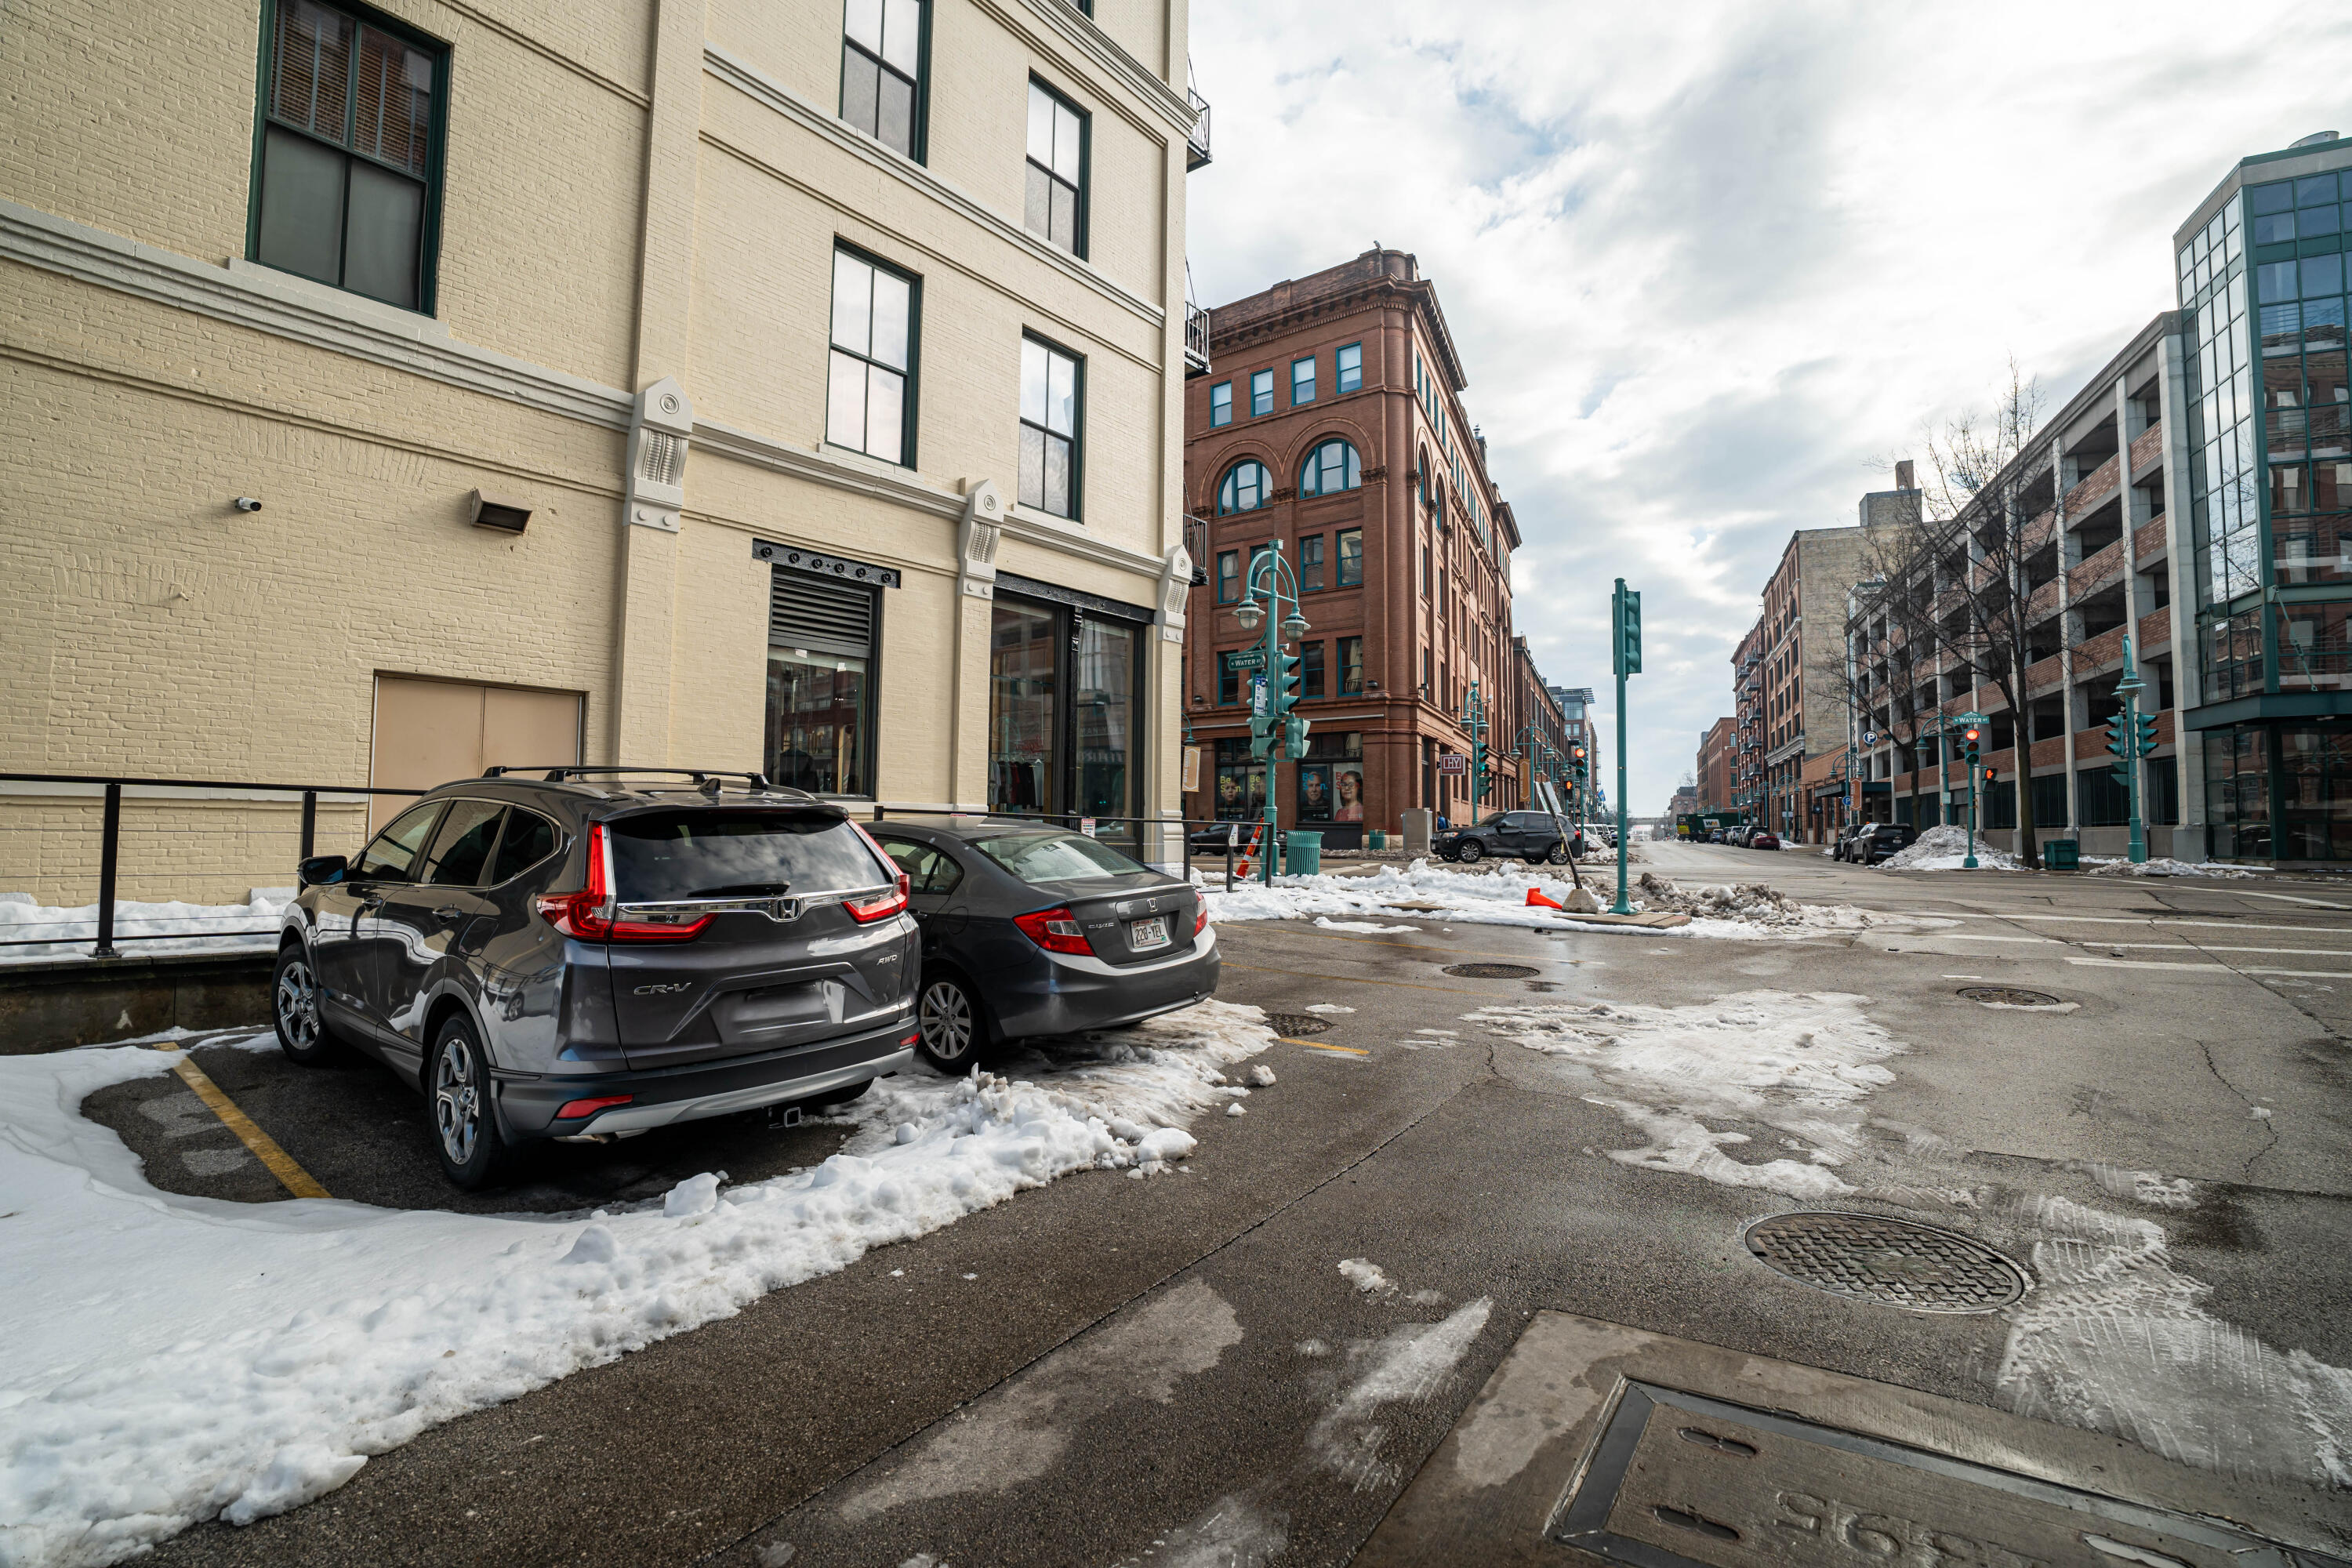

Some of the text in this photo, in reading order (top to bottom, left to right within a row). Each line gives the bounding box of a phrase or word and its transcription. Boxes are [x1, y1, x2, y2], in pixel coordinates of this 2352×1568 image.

[1220, 775, 1231, 785] Be
[1249, 774, 1261, 783] Be
[1302, 772, 1315, 782] Be
[877, 953, 898, 965] AWD
[633, 982, 691, 996] CR-V
